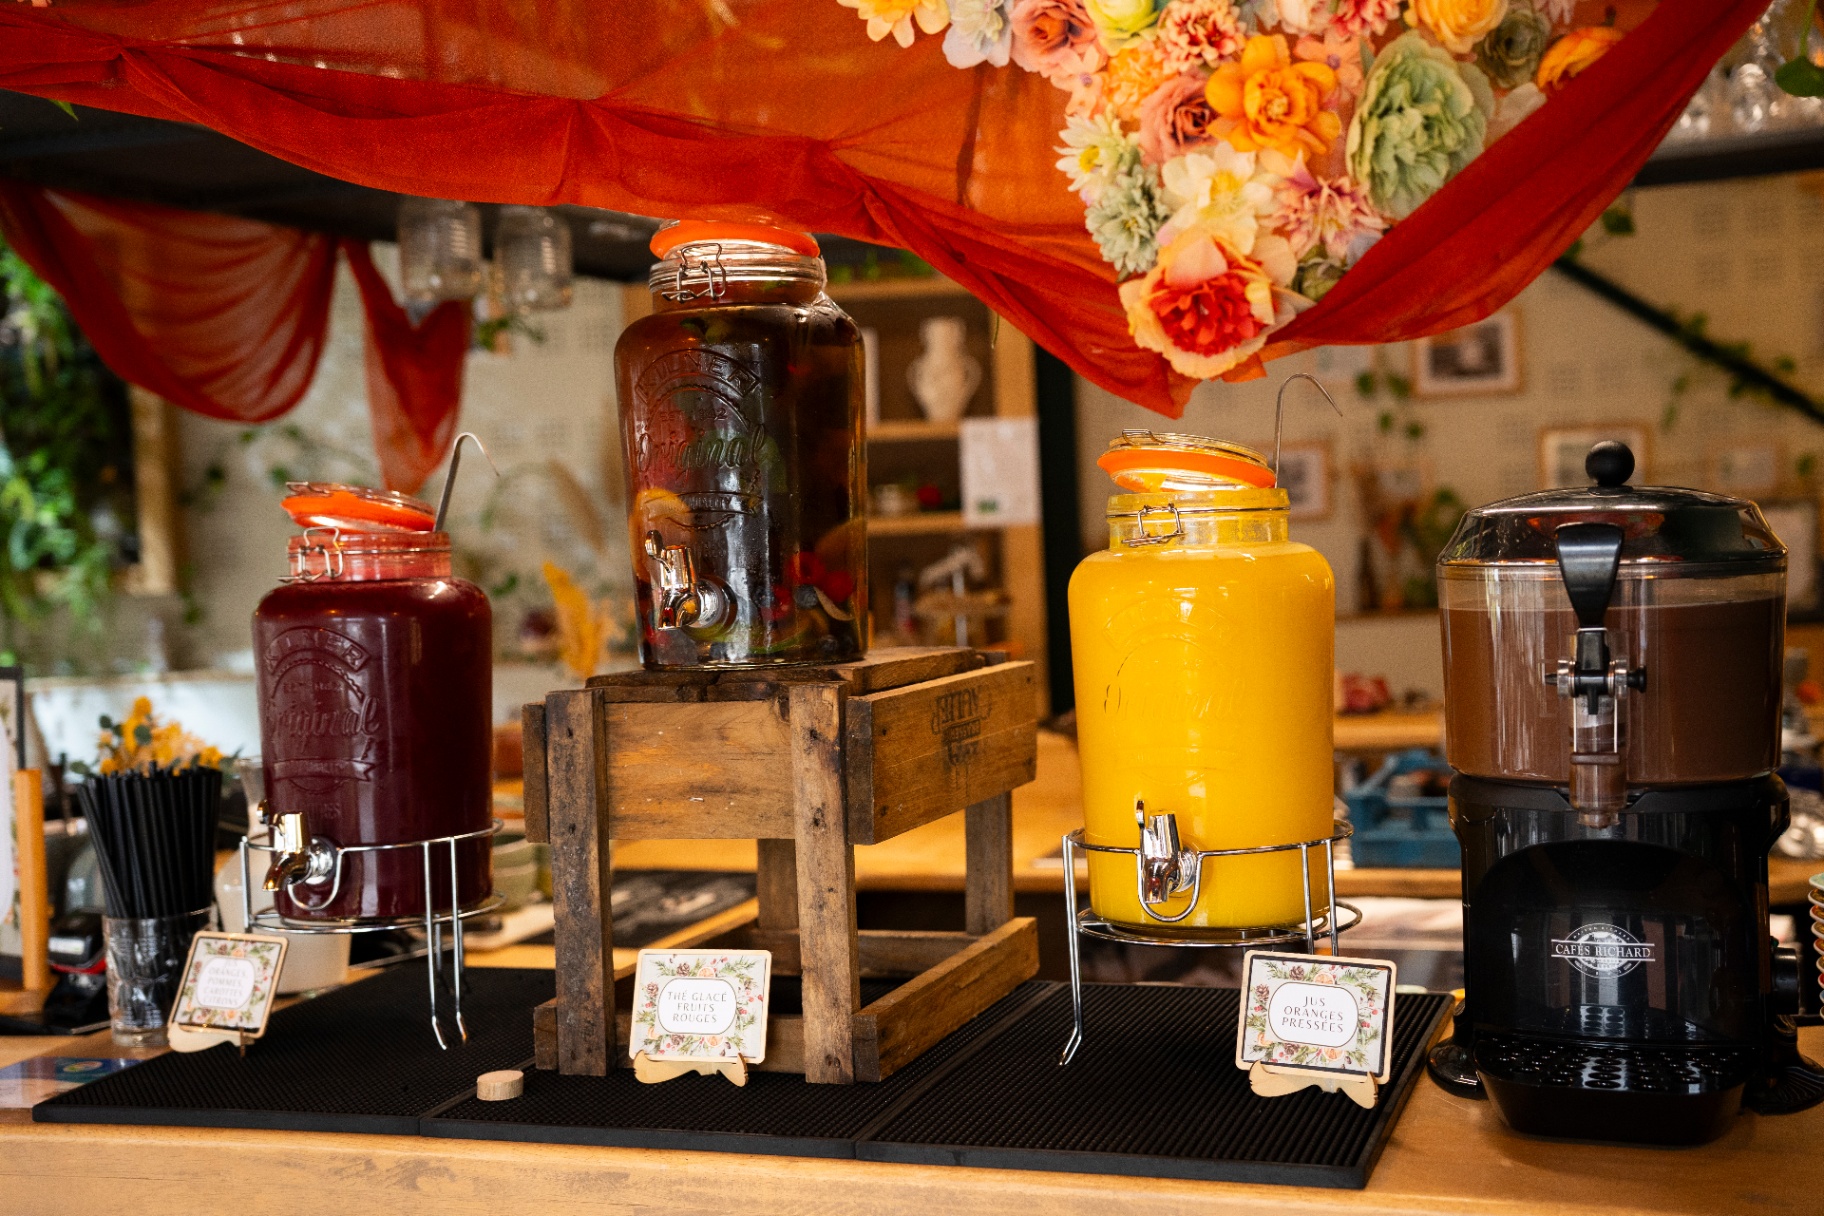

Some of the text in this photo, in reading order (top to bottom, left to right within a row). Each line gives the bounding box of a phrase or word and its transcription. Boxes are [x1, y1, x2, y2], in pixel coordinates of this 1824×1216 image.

[636, 423, 766, 489] Original
[1595, 945, 1651, 958] RICHARD
[667, 990, 728, 1002] THÉ GLACÉ
[1303, 995, 1325, 1008] JUS
[677, 1003, 715, 1012] FRUITS
[1284, 1005, 1344, 1021] ORANGES
[672, 1013, 717, 1023] ROUGES
[1282, 1016, 1344, 1033] PRESSÉES
